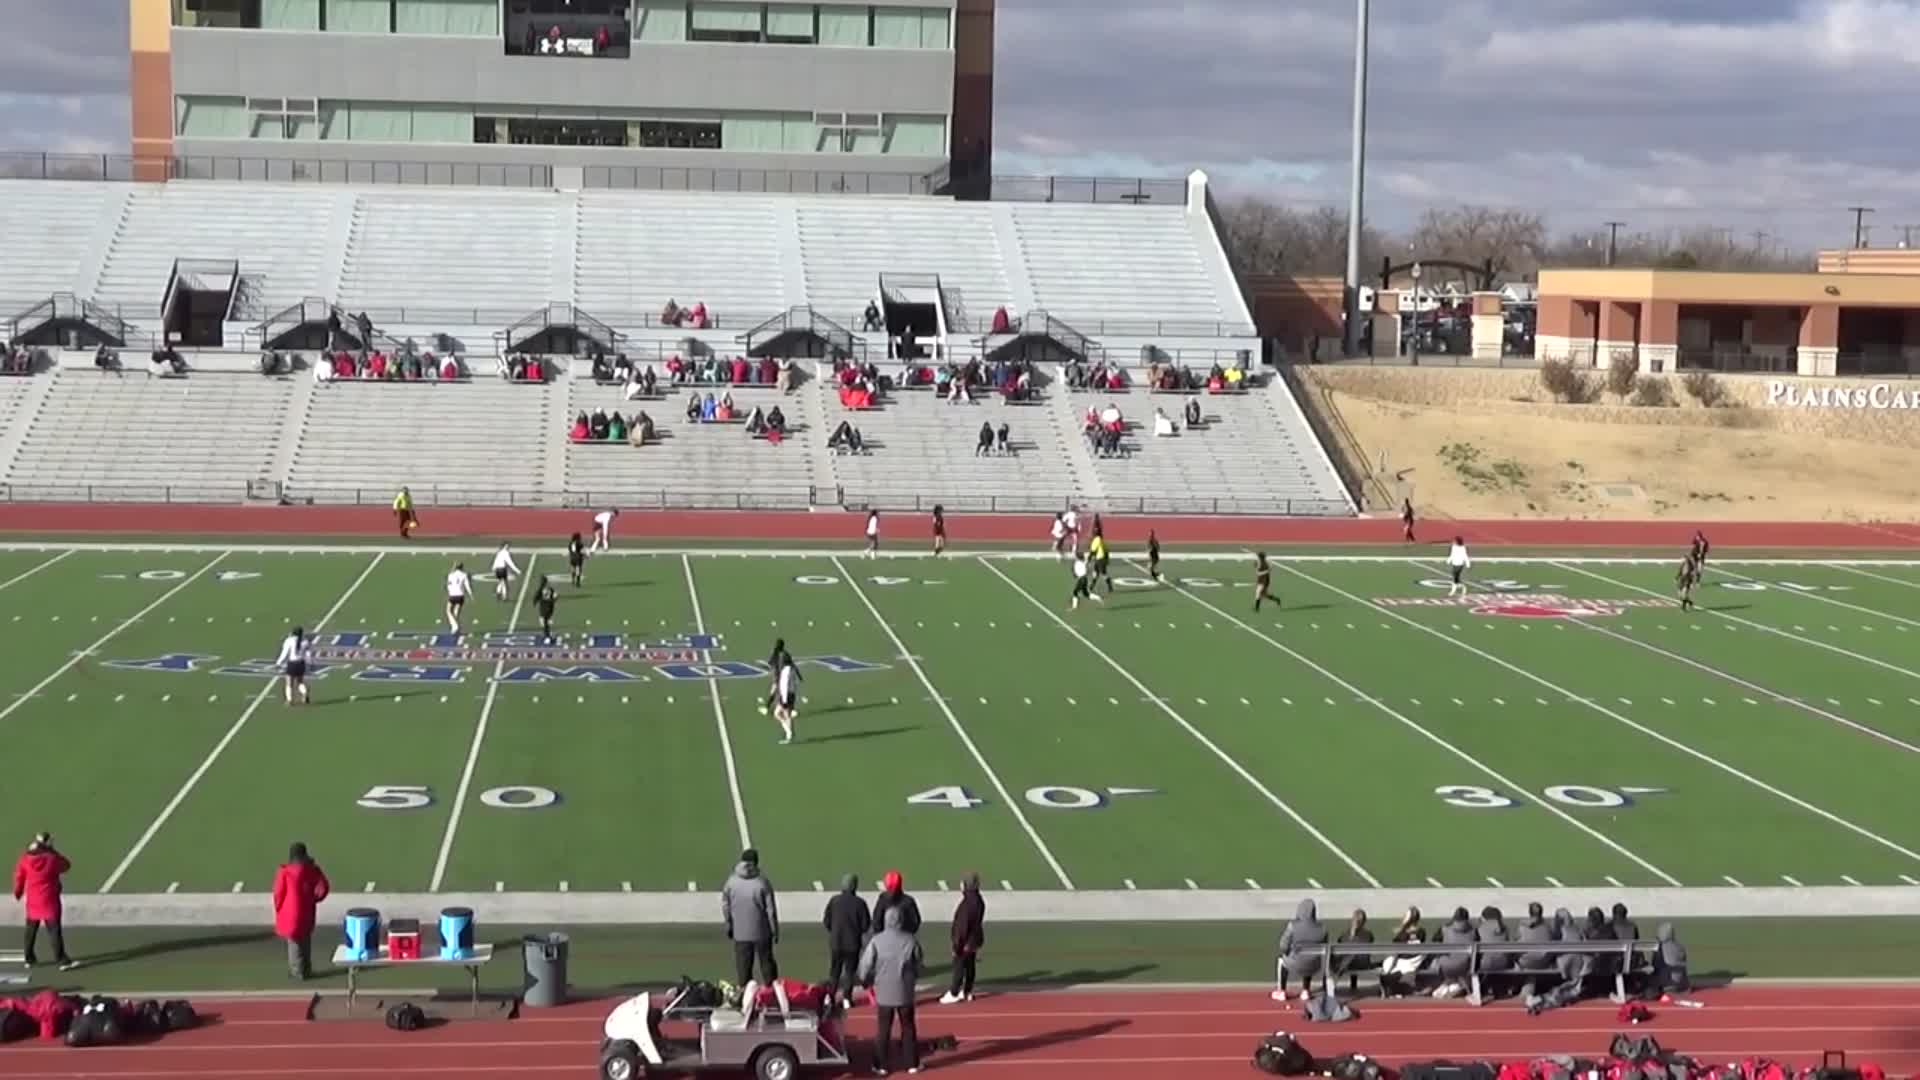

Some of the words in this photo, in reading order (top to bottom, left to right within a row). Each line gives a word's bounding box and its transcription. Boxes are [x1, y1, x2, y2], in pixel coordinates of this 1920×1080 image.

[356, 785, 556, 808] 50
[907, 785, 1101, 808] 40
[1434, 785, 1625, 807] 30
